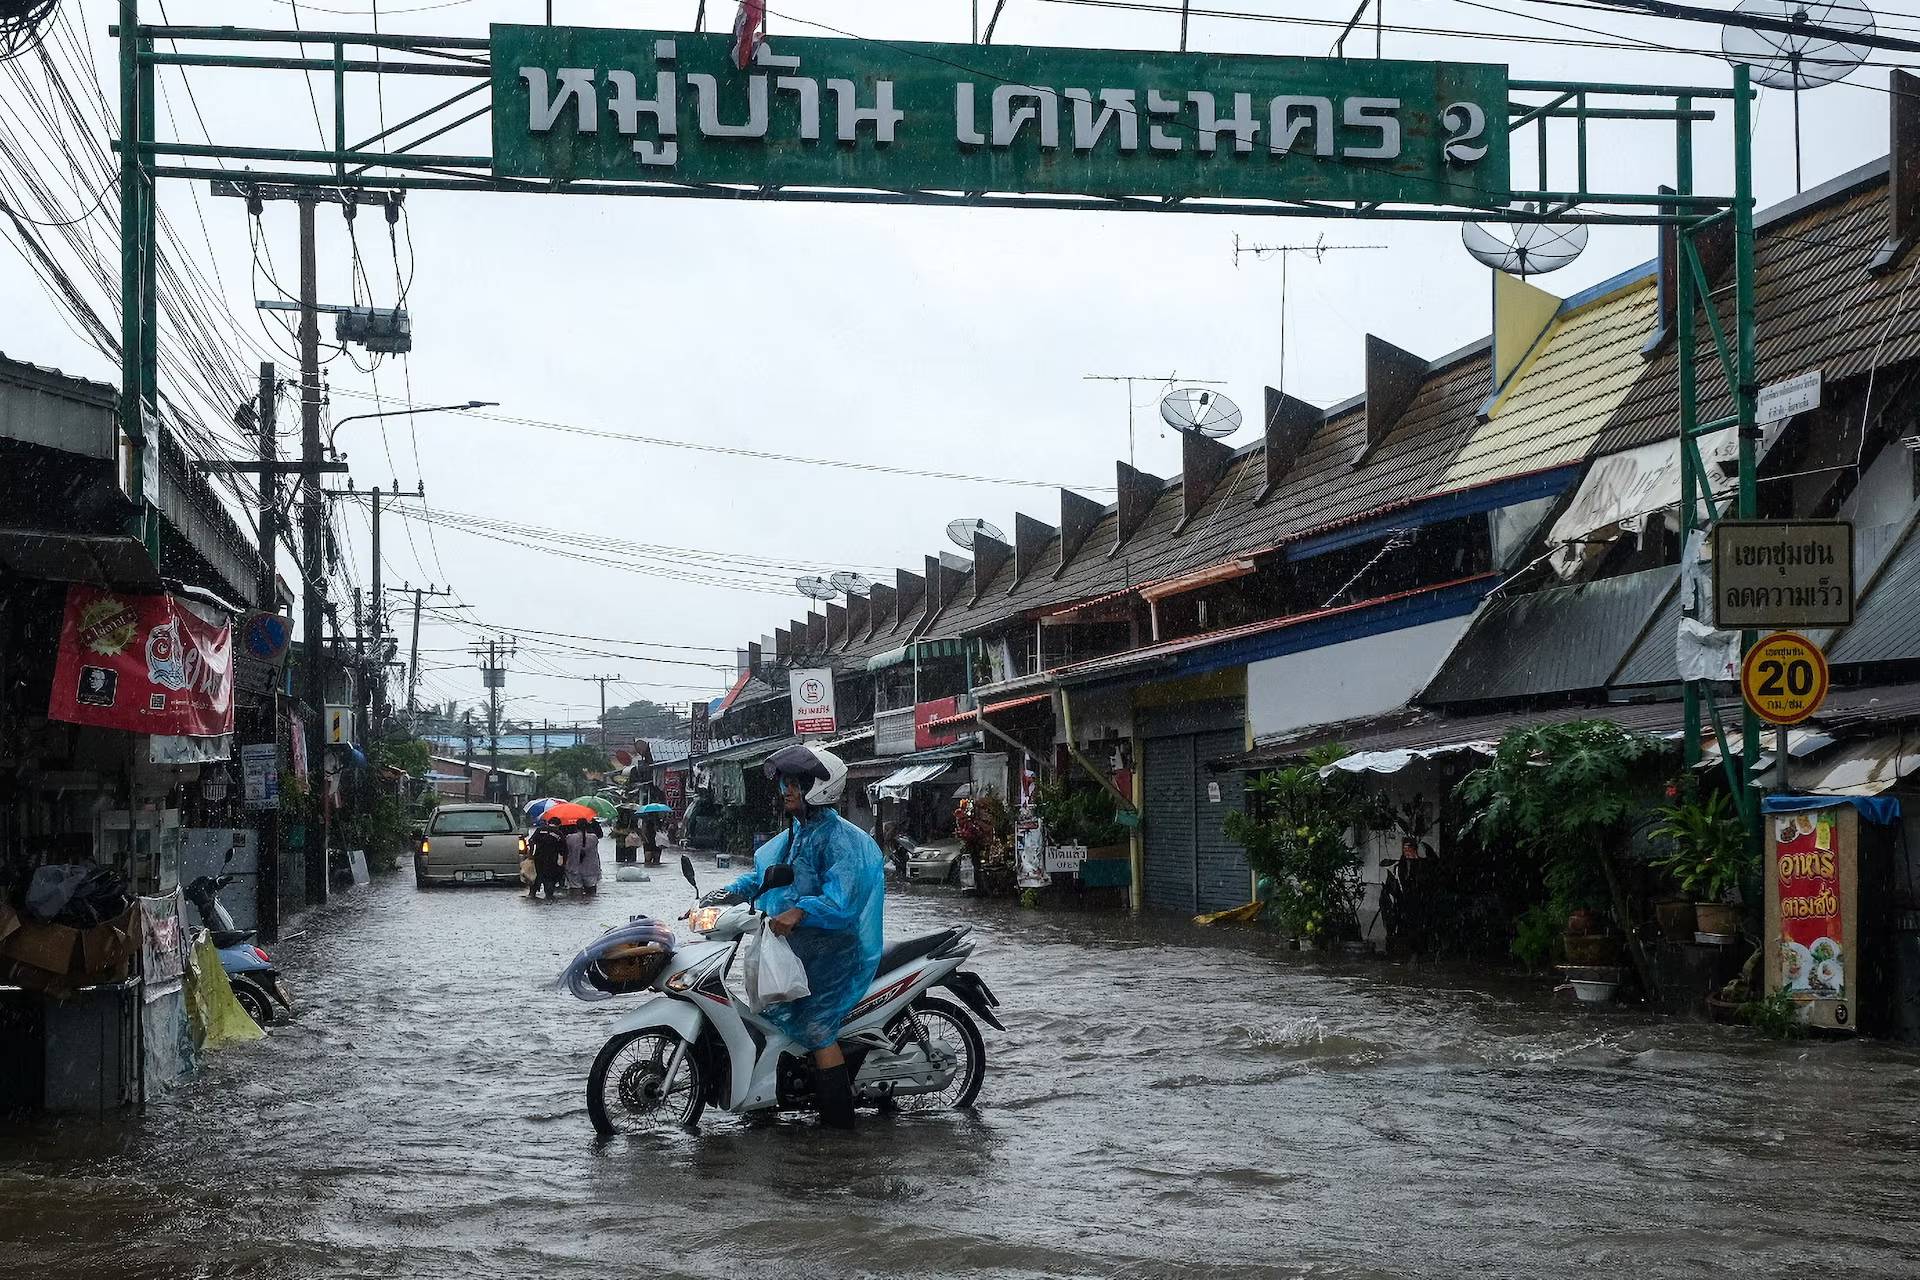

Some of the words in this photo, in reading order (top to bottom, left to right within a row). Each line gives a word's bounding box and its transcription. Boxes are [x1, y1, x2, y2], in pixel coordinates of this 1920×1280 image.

[518, 38, 904, 167] หมู่บ้าน
[956, 82, 1402, 159] เคหะนคร
[1441, 101, 1489, 163] 2
[1735, 541, 1834, 576] เขตชุมชน
[1726, 576, 1843, 608] ลดความเร็ว
[1757, 659, 1814, 696] 20
[1780, 850, 1836, 886] อาหาร
[1783, 882, 1838, 918] ตามสั่ง
